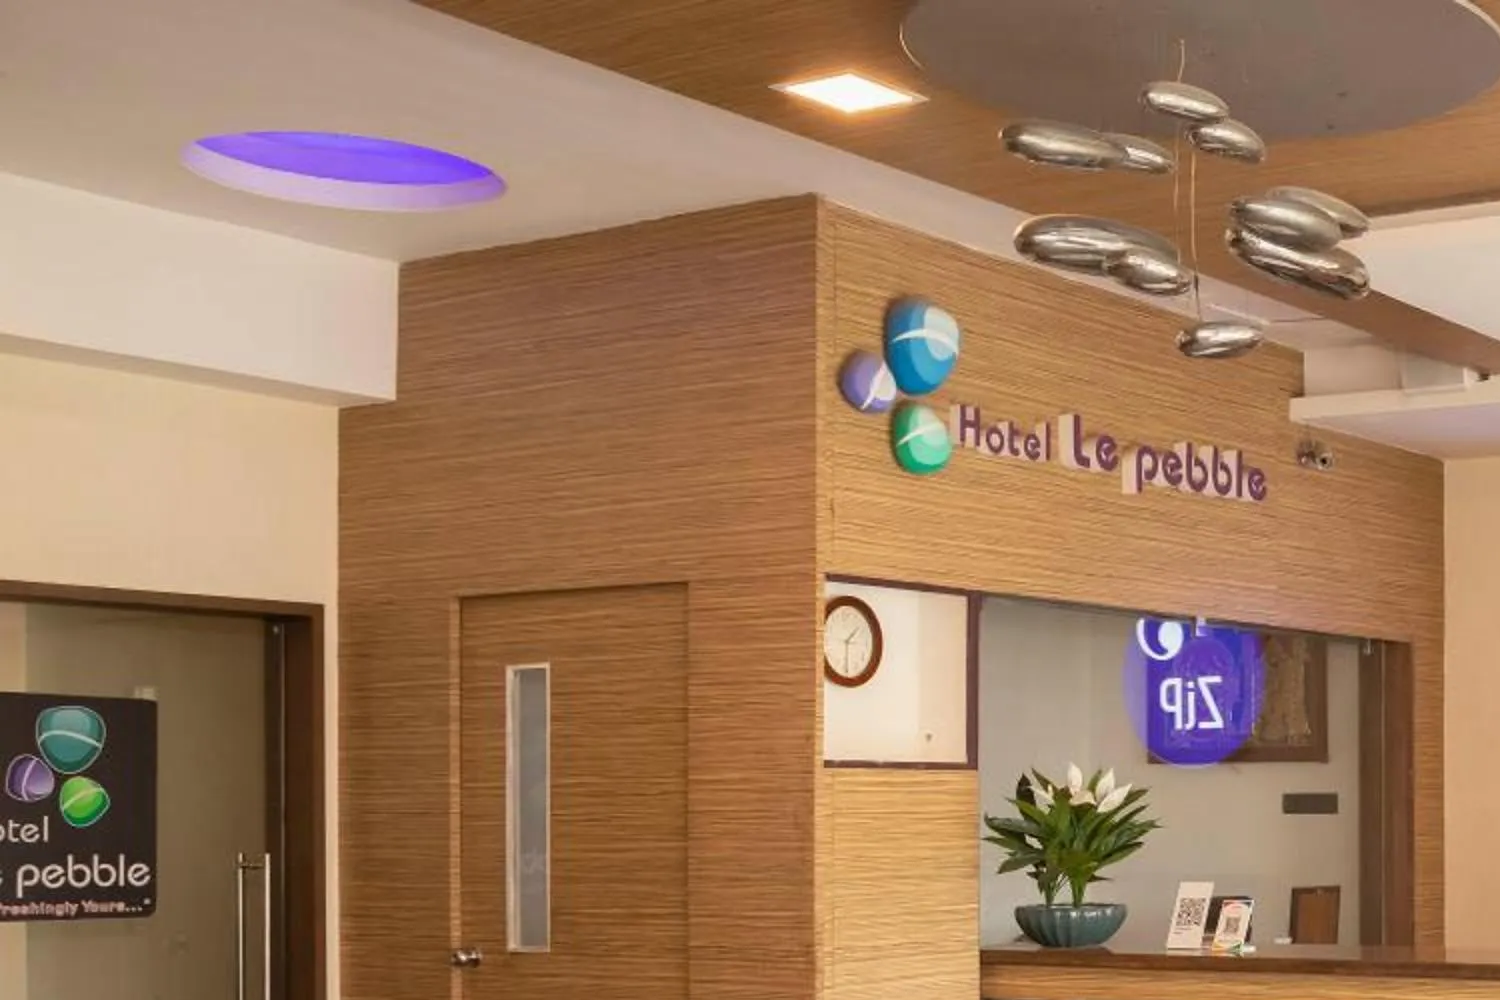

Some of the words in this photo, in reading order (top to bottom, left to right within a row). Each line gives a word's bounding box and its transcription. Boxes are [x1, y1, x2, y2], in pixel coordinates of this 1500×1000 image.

[957, 404, 1051, 462] Hotel
[1072, 413, 1118, 472] Le
[1134, 442, 1268, 501] pebble
[0, 815, 49, 843] tel
[16, 853, 151, 899] pebble
